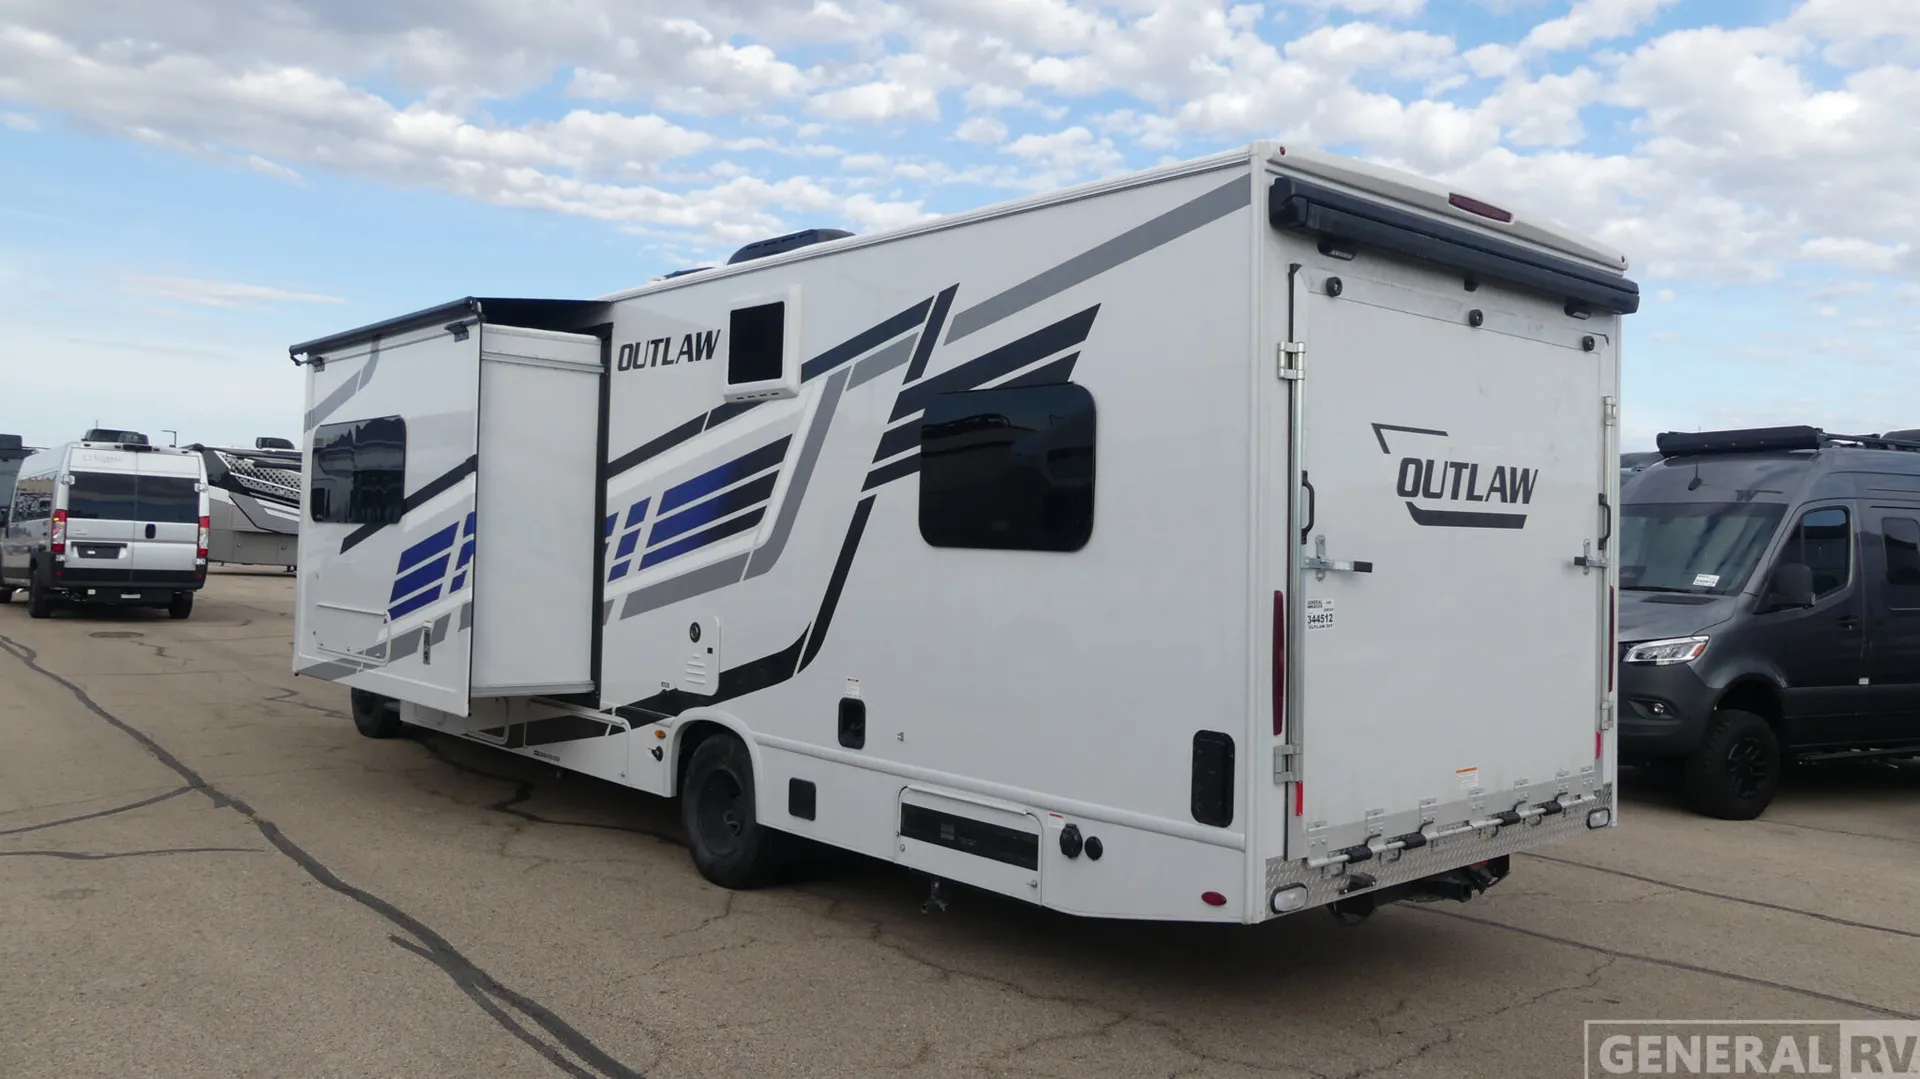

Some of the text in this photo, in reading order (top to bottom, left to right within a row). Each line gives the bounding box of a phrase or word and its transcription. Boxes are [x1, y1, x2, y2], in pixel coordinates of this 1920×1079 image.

[617, 329, 721, 372] OUTLAW
[1396, 457, 1539, 505] OUTLAW
[1307, 613, 1333, 624] 344512
